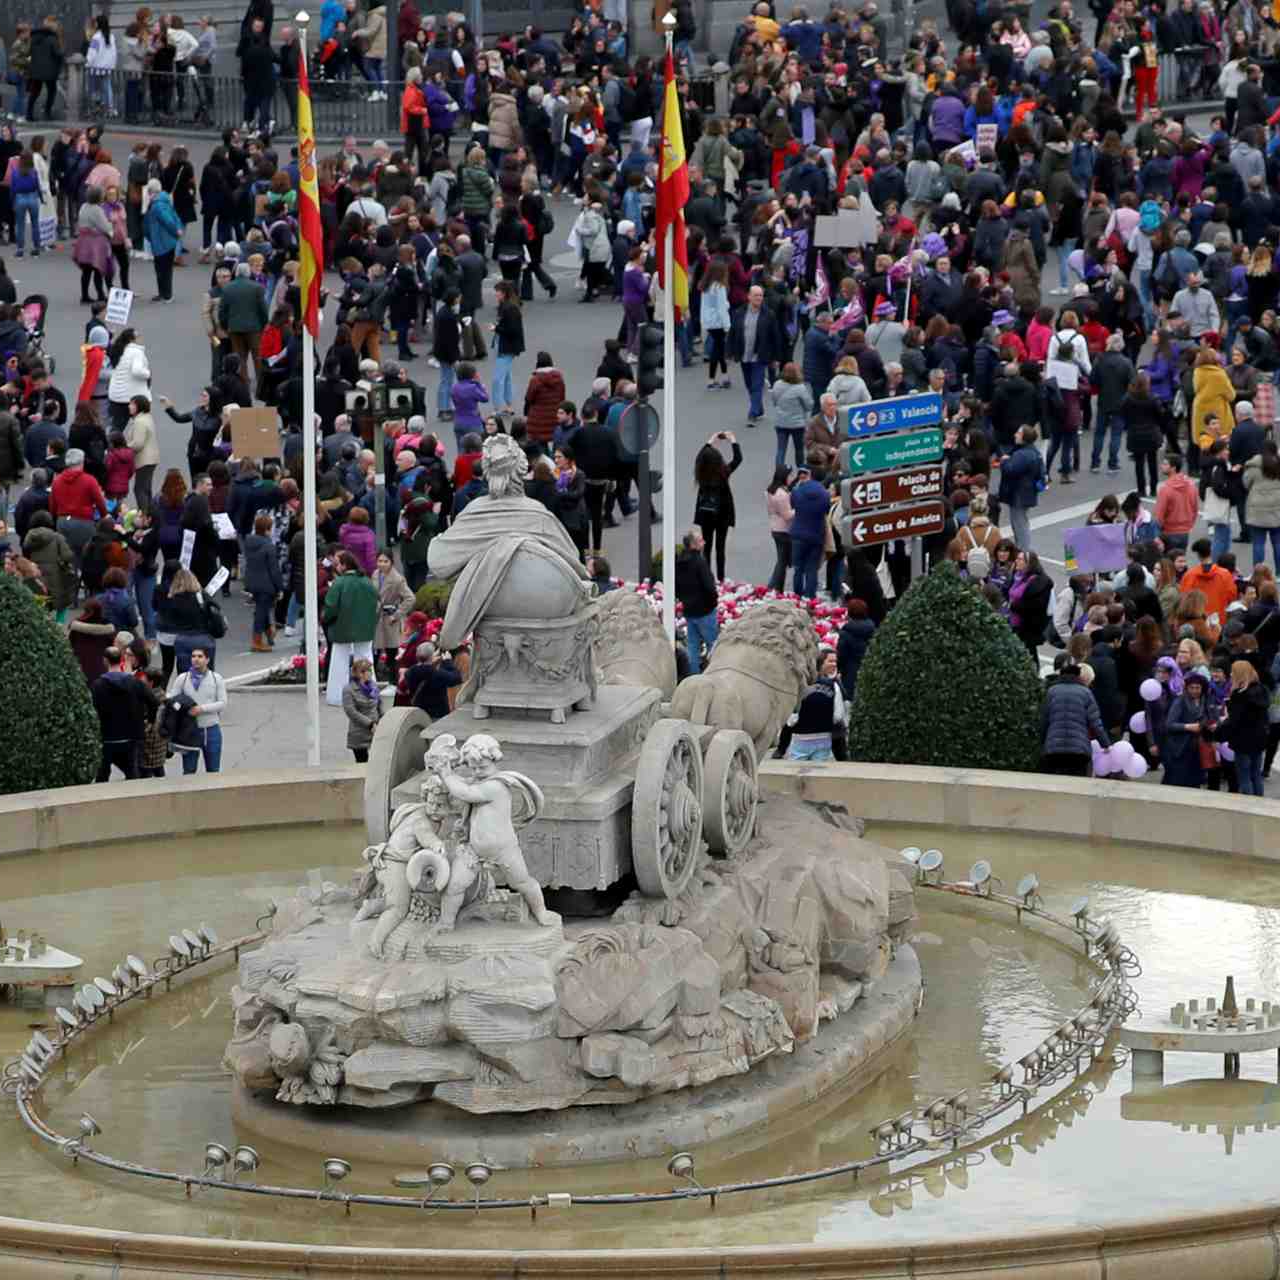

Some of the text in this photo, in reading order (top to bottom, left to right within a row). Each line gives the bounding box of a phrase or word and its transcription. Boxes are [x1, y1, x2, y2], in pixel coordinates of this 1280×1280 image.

[901, 403, 938, 419] Valencia
[898, 471, 940, 487] Palacio de
[911, 482, 940, 496] Cibeles
[873, 514, 941, 534] Casa de América
